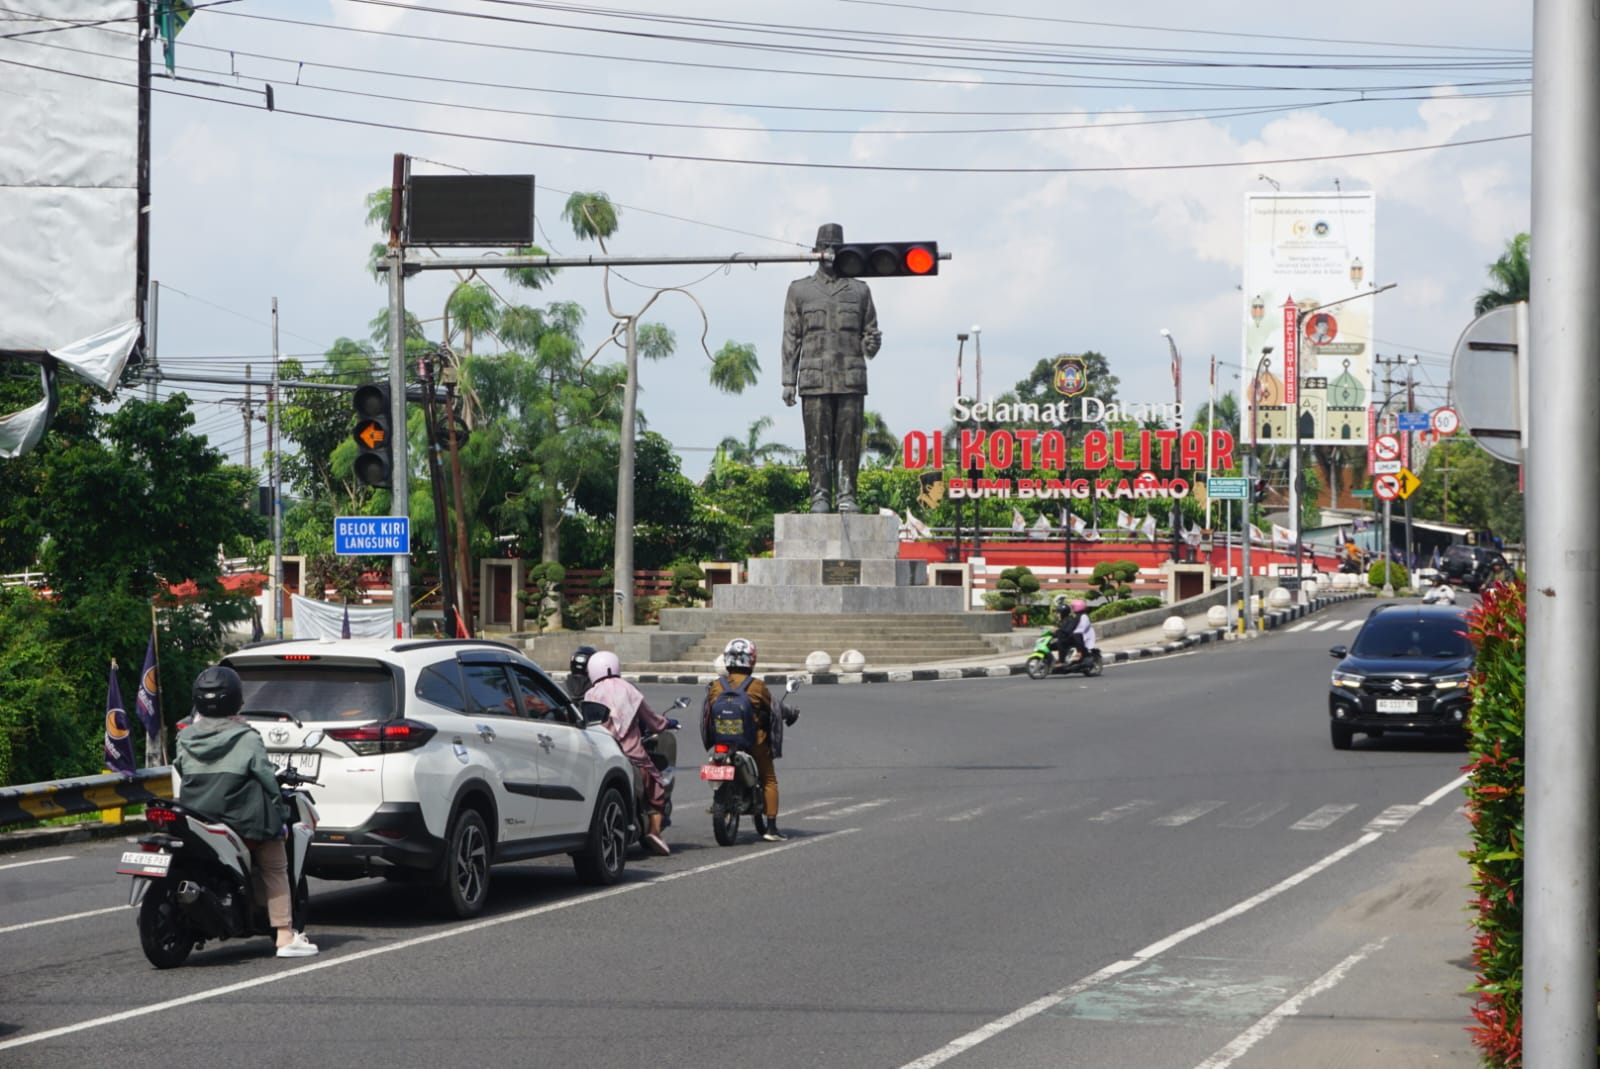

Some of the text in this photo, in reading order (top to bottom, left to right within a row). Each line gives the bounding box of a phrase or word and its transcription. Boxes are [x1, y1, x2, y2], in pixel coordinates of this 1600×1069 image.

[952, 396, 1185, 428] Selamat Datang
[903, 429, 1234, 470] DI KOTA BLITAR
[948, 478, 1011, 499] BUMI
[1017, 478, 1088, 499] BUNG
[1095, 478, 1190, 499] KARNO
[340, 522, 405, 535] BELOK KIRI
[345, 537, 400, 549] LANGSUNG
